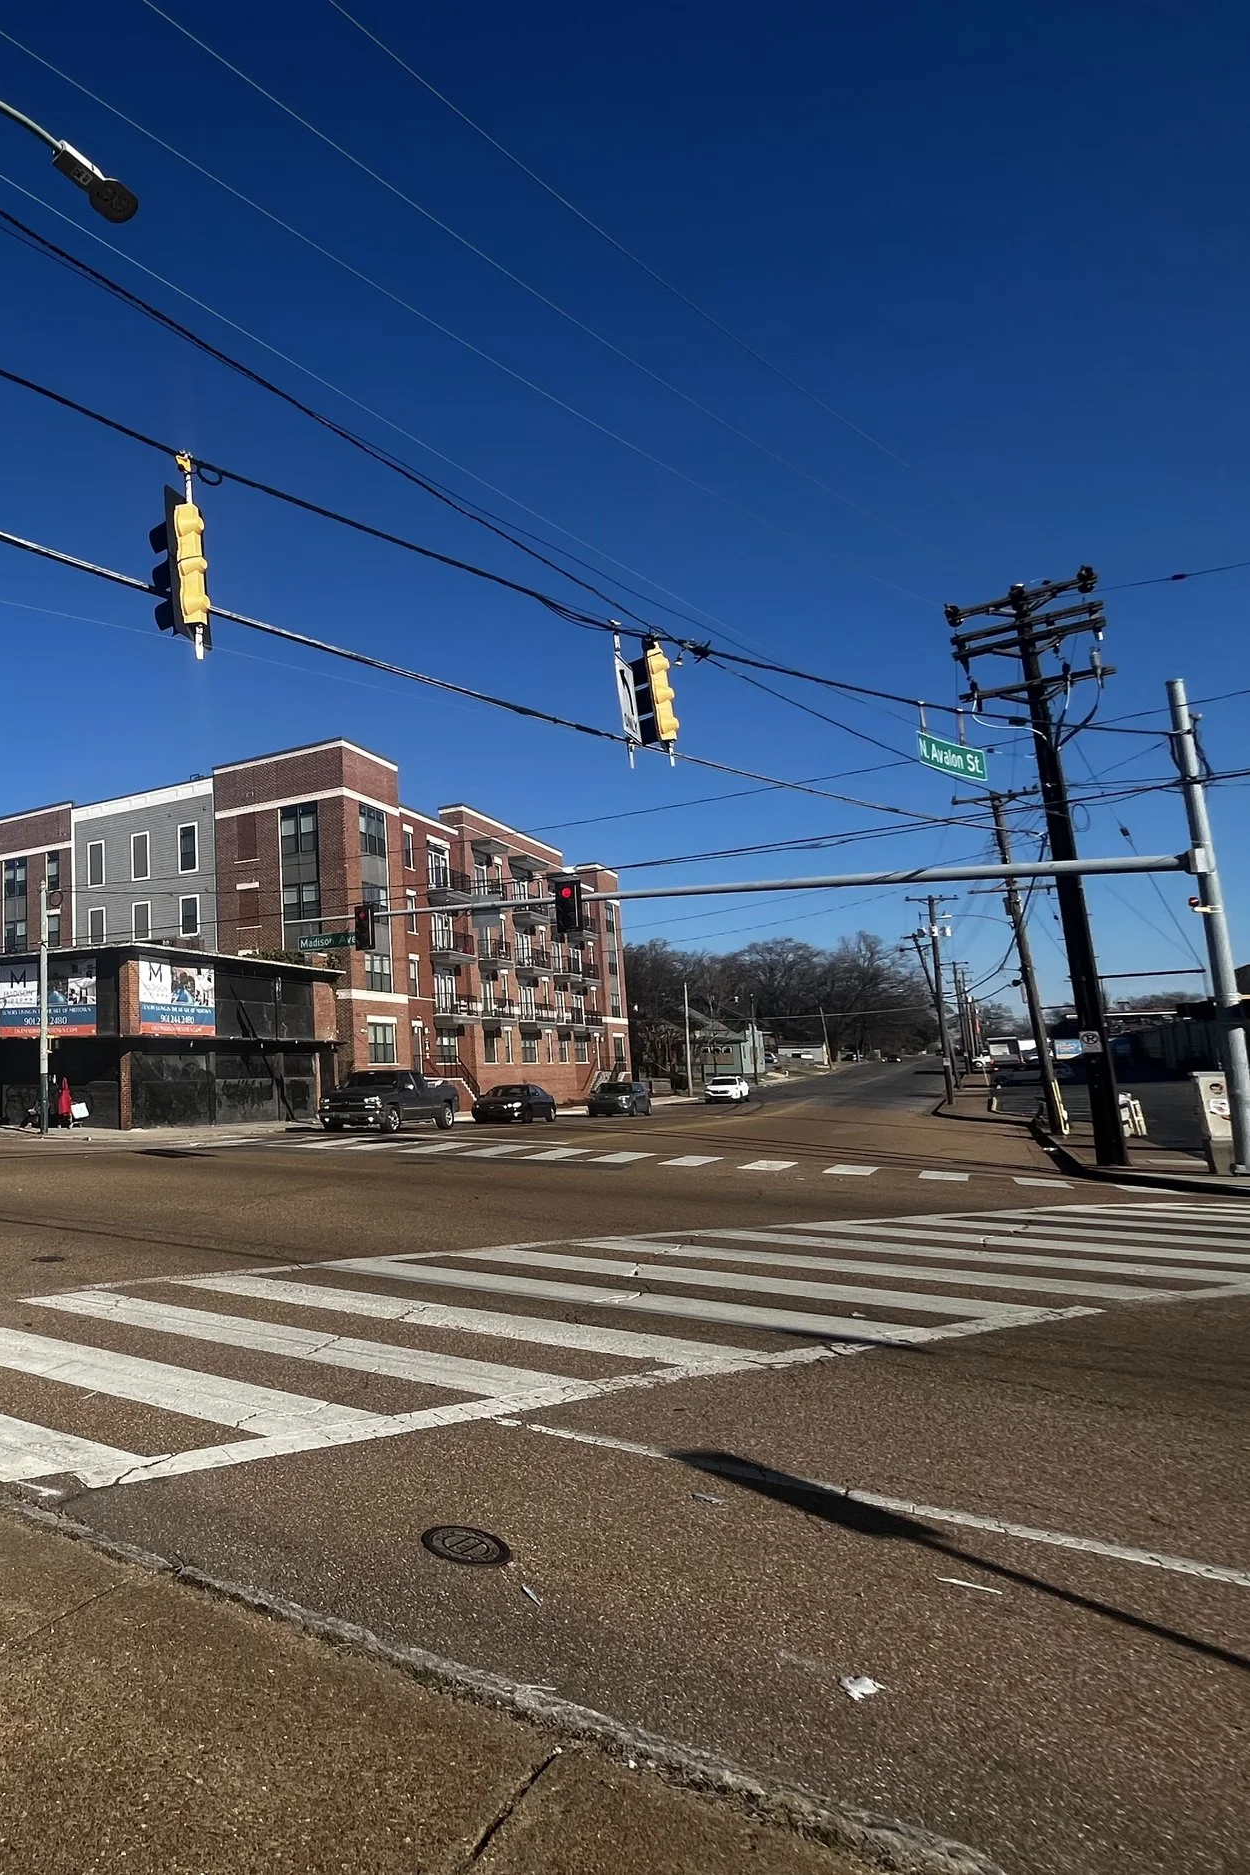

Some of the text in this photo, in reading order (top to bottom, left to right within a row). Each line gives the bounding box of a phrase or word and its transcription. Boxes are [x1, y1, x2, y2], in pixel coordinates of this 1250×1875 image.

[931, 743, 964, 770] Avalon
[966, 753, 984, 774] St.
[300, 937, 335, 949] Madison
[10, 968, 27, 988] M
[148, 961, 163, 983] M
